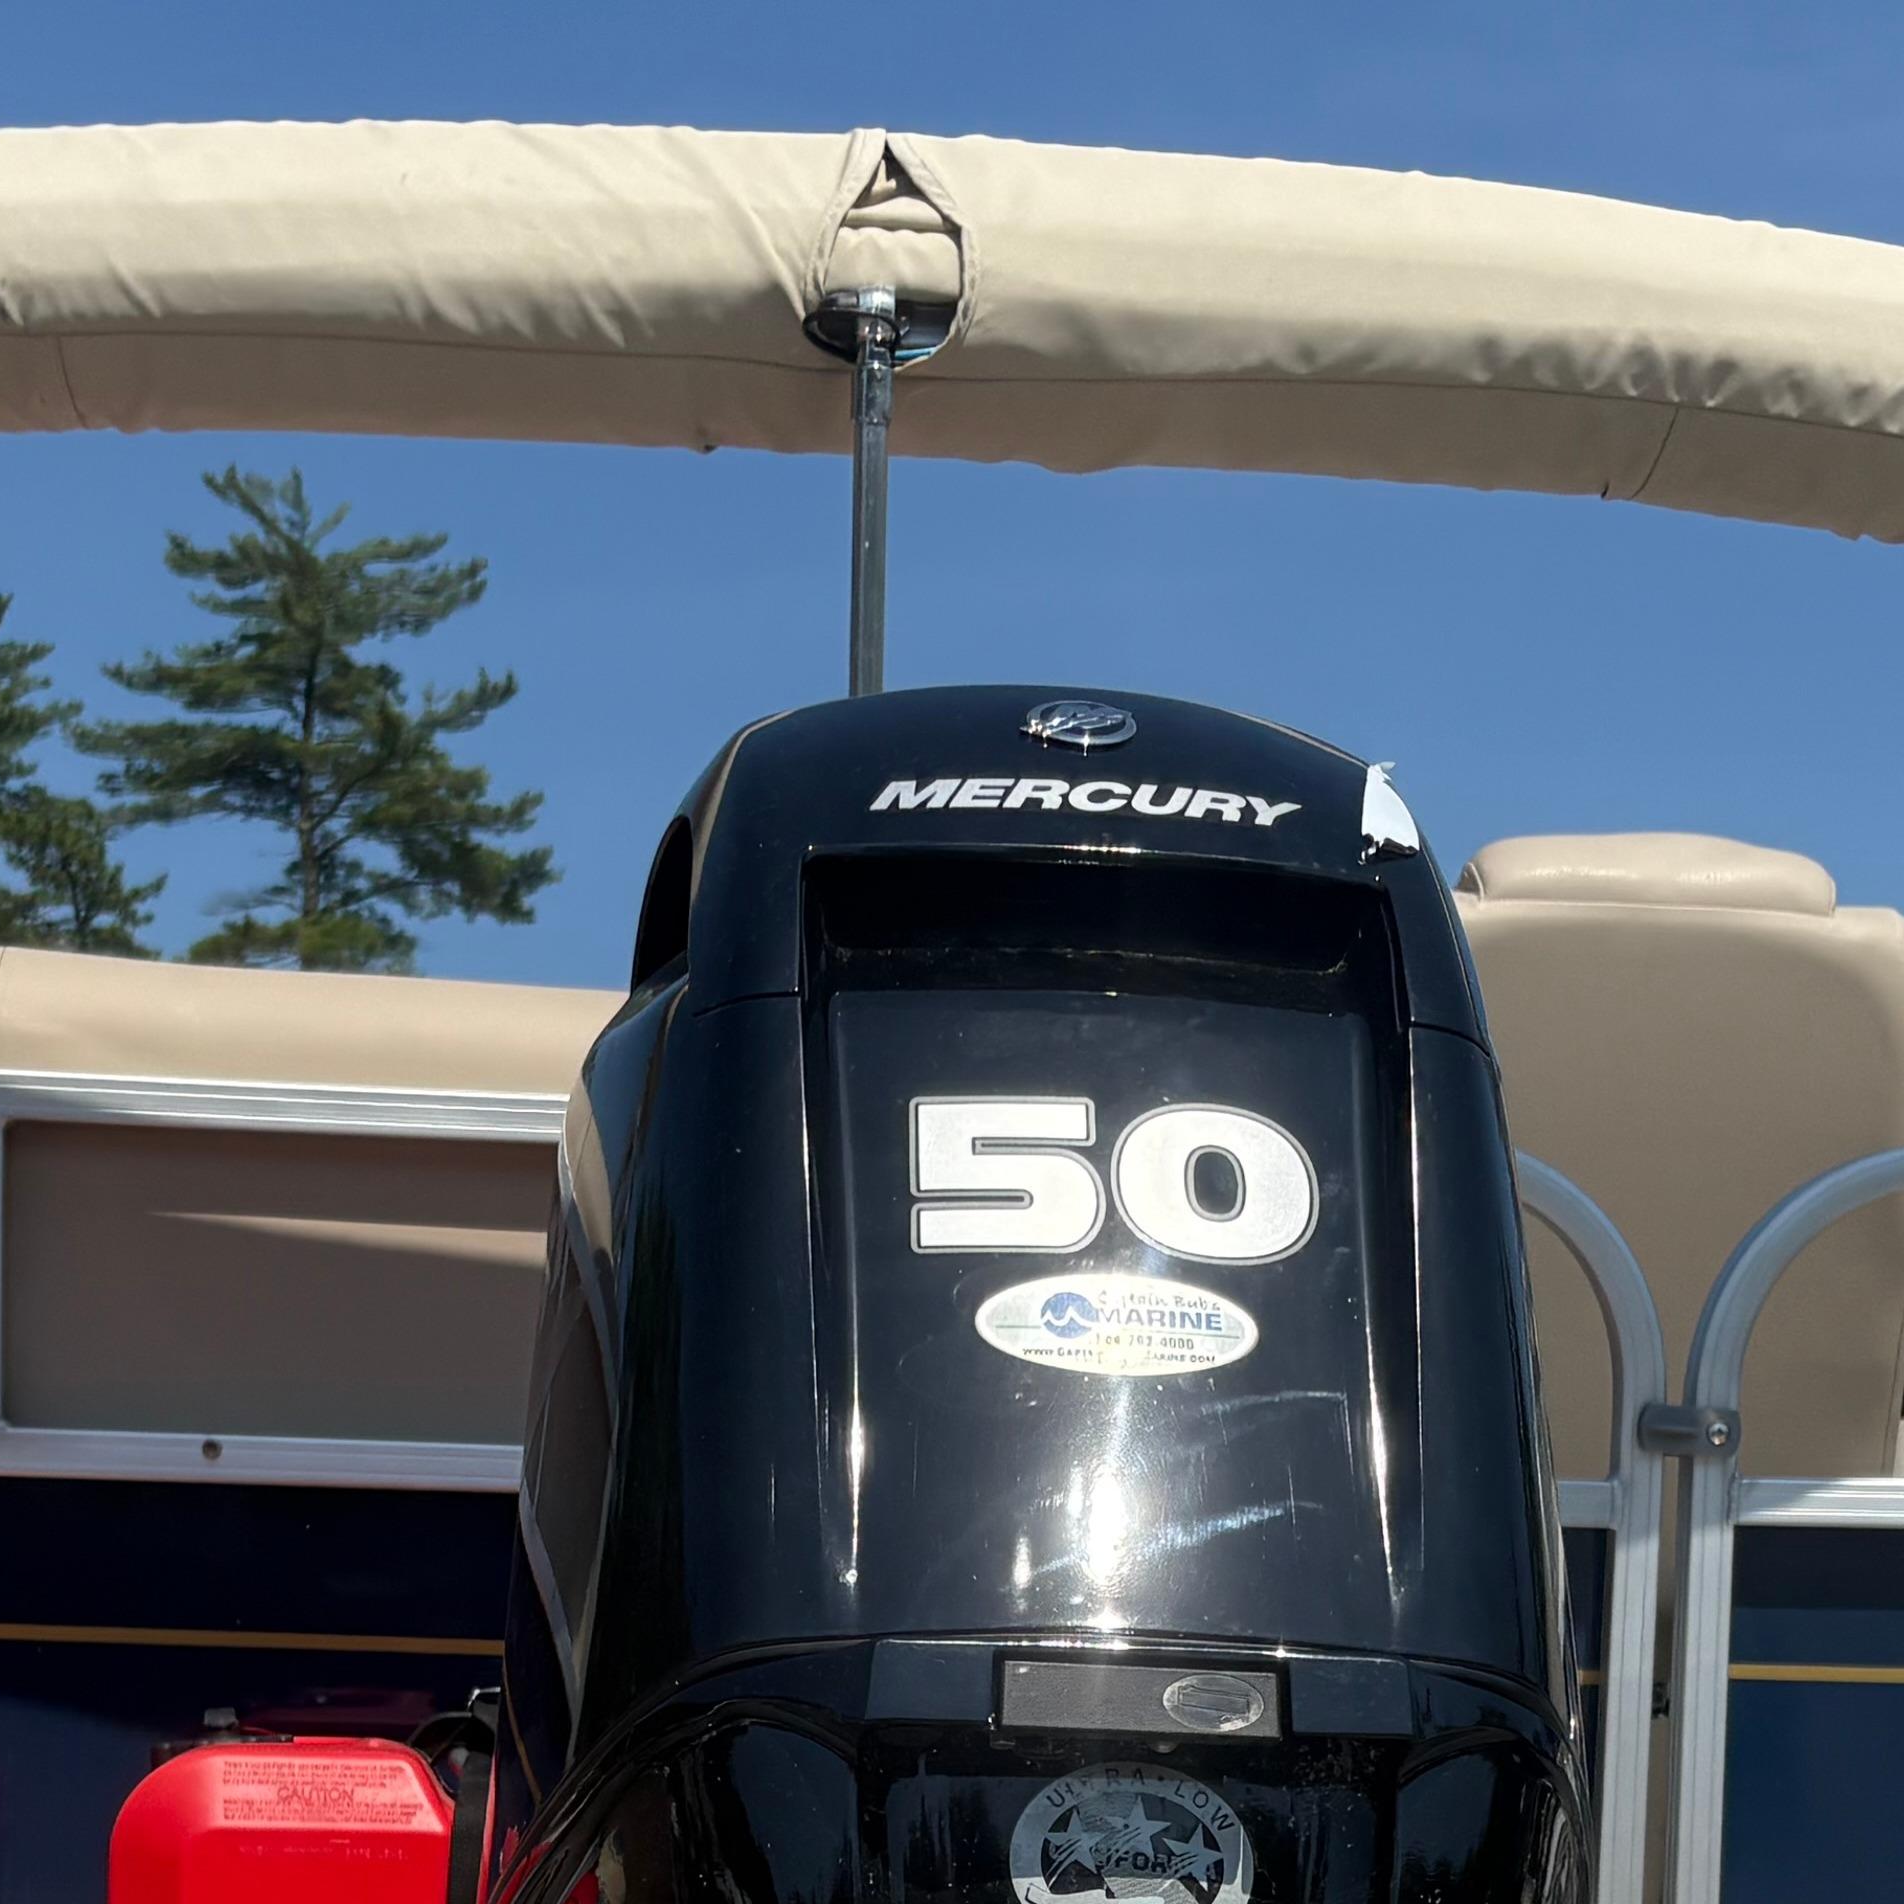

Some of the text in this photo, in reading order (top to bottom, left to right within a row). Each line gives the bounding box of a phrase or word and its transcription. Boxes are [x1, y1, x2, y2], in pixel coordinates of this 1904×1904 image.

[869, 778, 1303, 827] MERCURY
[909, 1096, 1319, 1266] 50
[1095, 1308, 1222, 1332] MARINE
[1173, 1778, 1236, 1833] LOW
